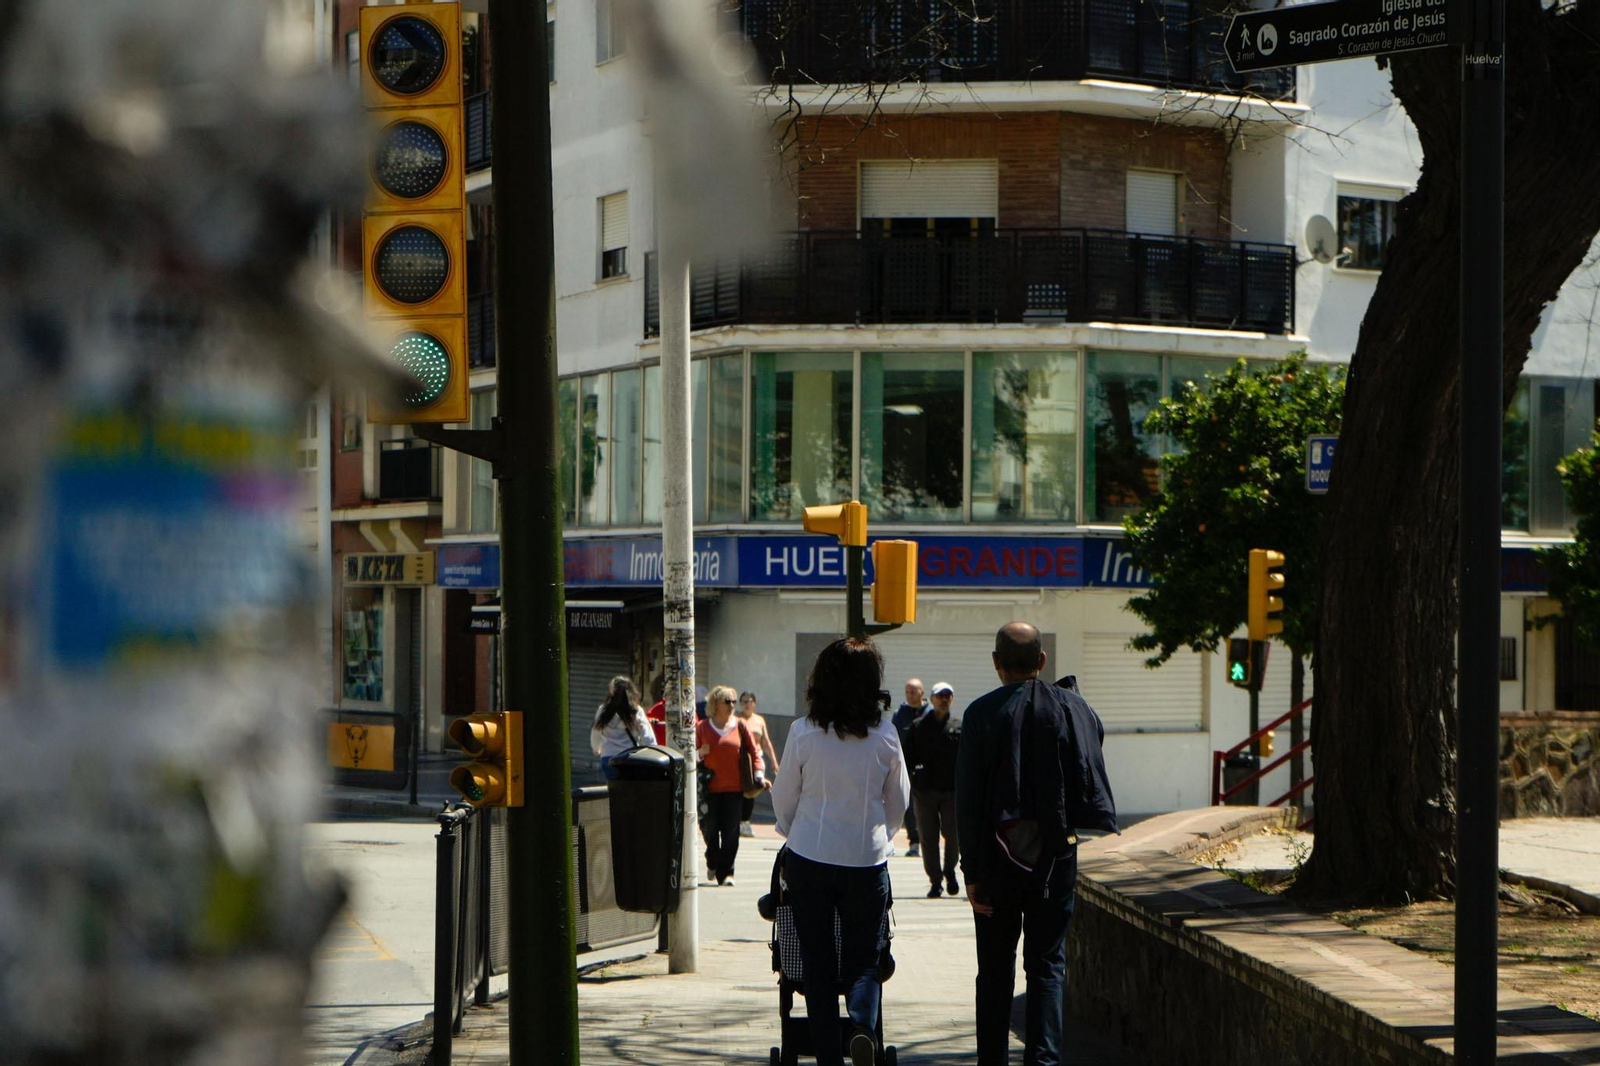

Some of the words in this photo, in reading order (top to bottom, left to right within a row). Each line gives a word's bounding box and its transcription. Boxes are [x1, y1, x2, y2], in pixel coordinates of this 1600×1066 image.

[1289, 25, 1338, 46] Sagrado
[1341, 17, 1390, 38] Corazón
[1393, 15, 1409, 31] de
[1412, 9, 1446, 31] Jesús
[1236, 51, 1242, 62] 3
[1242, 50, 1256, 63] min
[1338, 43, 1346, 55] S.
[1347, 39, 1380, 53] Corazón
[1381, 37, 1392, 49] de
[1393, 34, 1415, 50] Jesús
[1417, 30, 1446, 45] Church
[921, 546, 1078, 577] GRANDE
